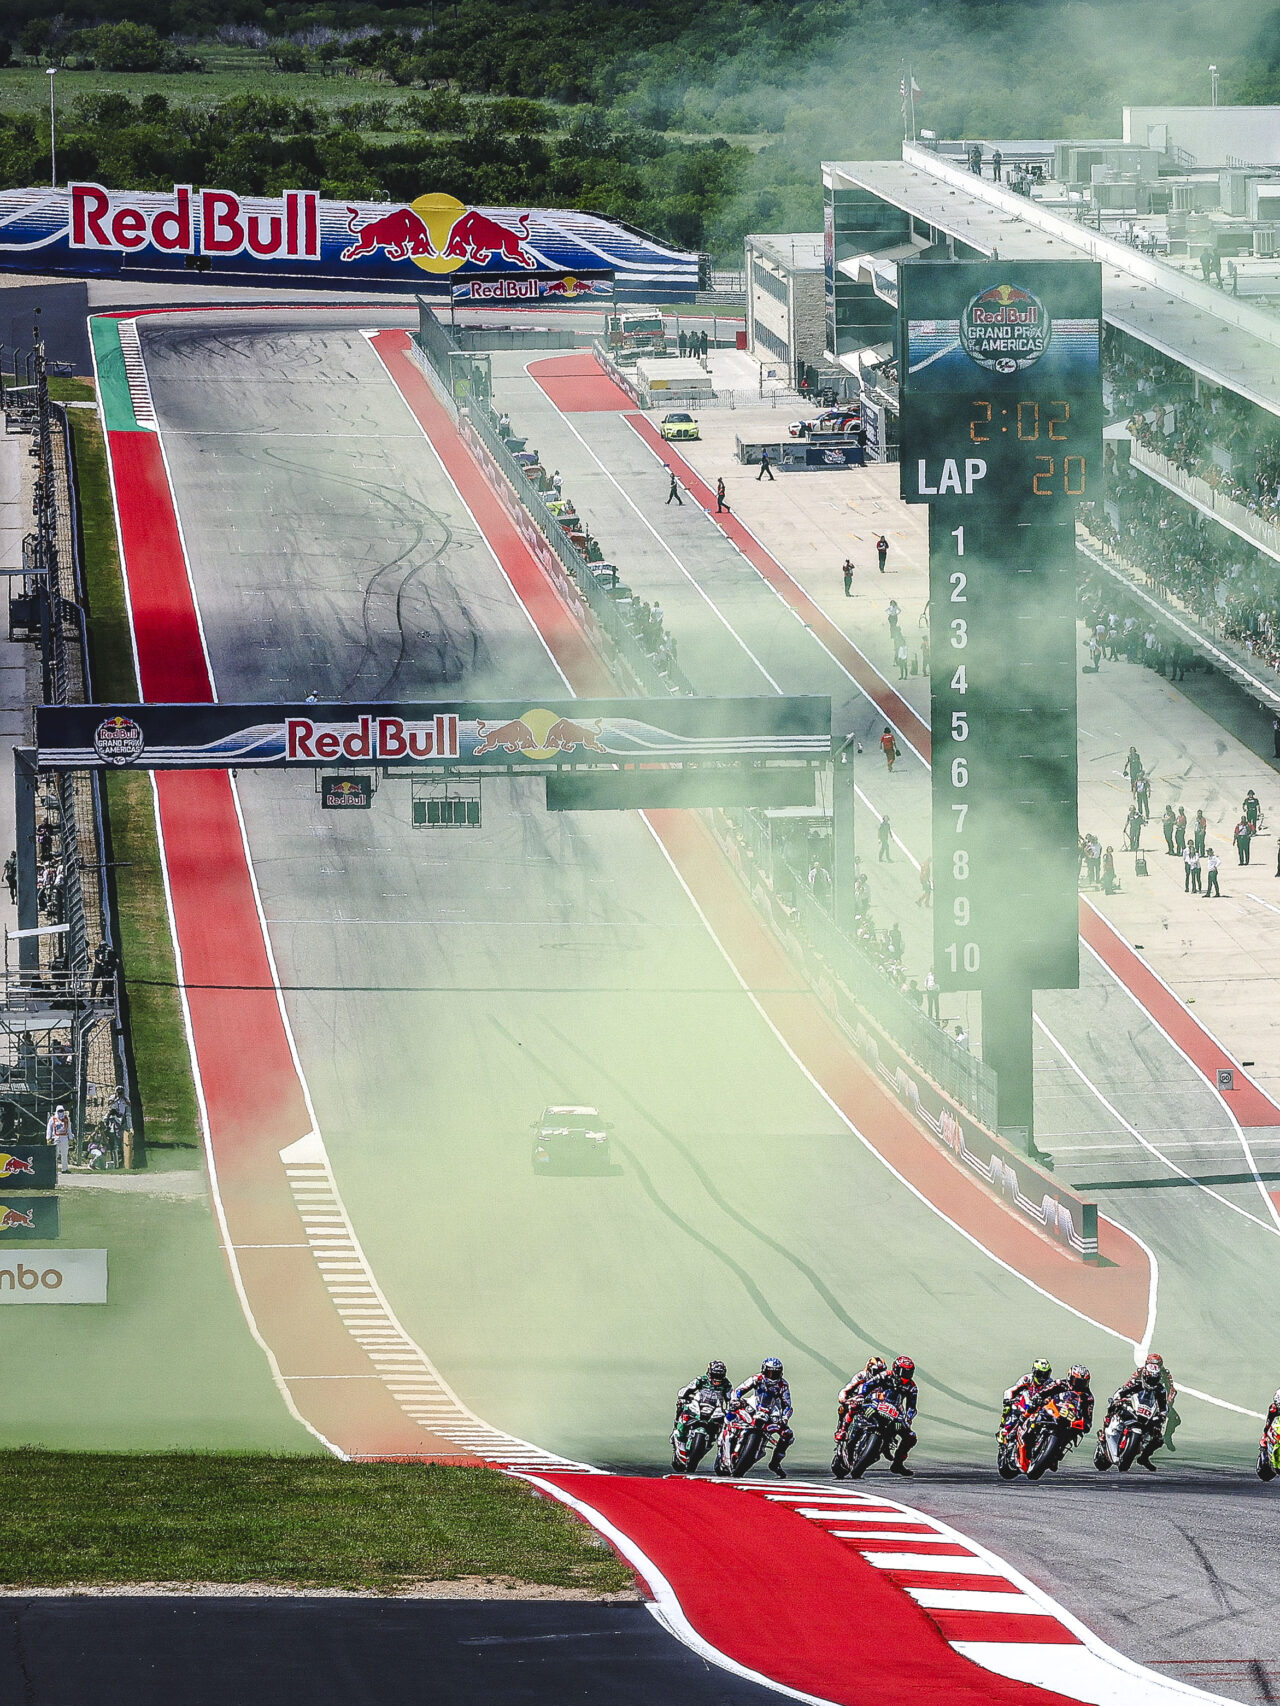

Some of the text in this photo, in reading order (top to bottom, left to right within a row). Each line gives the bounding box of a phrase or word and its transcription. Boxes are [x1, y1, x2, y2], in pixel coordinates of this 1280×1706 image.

[69, 183, 319, 258] Red Bull
[471, 280, 539, 298] Red Bull
[973, 307, 1038, 324] Red Bull
[968, 326, 1011, 338] GRAND
[981, 339, 1043, 351] AMERICAS
[970, 401, 1070, 441] 2:02
[918, 458, 987, 495] LAP
[1033, 456, 1086, 495] 20
[951, 526, 965, 555] 1
[949, 573, 967, 602] 2
[950, 619, 968, 648] 3
[950, 665, 968, 694] 4
[101, 729, 137, 739] Red Bull
[286, 715, 459, 760] Red Bull
[951, 712, 969, 741] 5
[951, 758, 969, 788] 6
[327, 795, 366, 805] Red Bull
[951, 804, 969, 833] 7
[952, 850, 970, 880] 8
[953, 897, 970, 926] 9
[945, 943, 980, 972] 10
